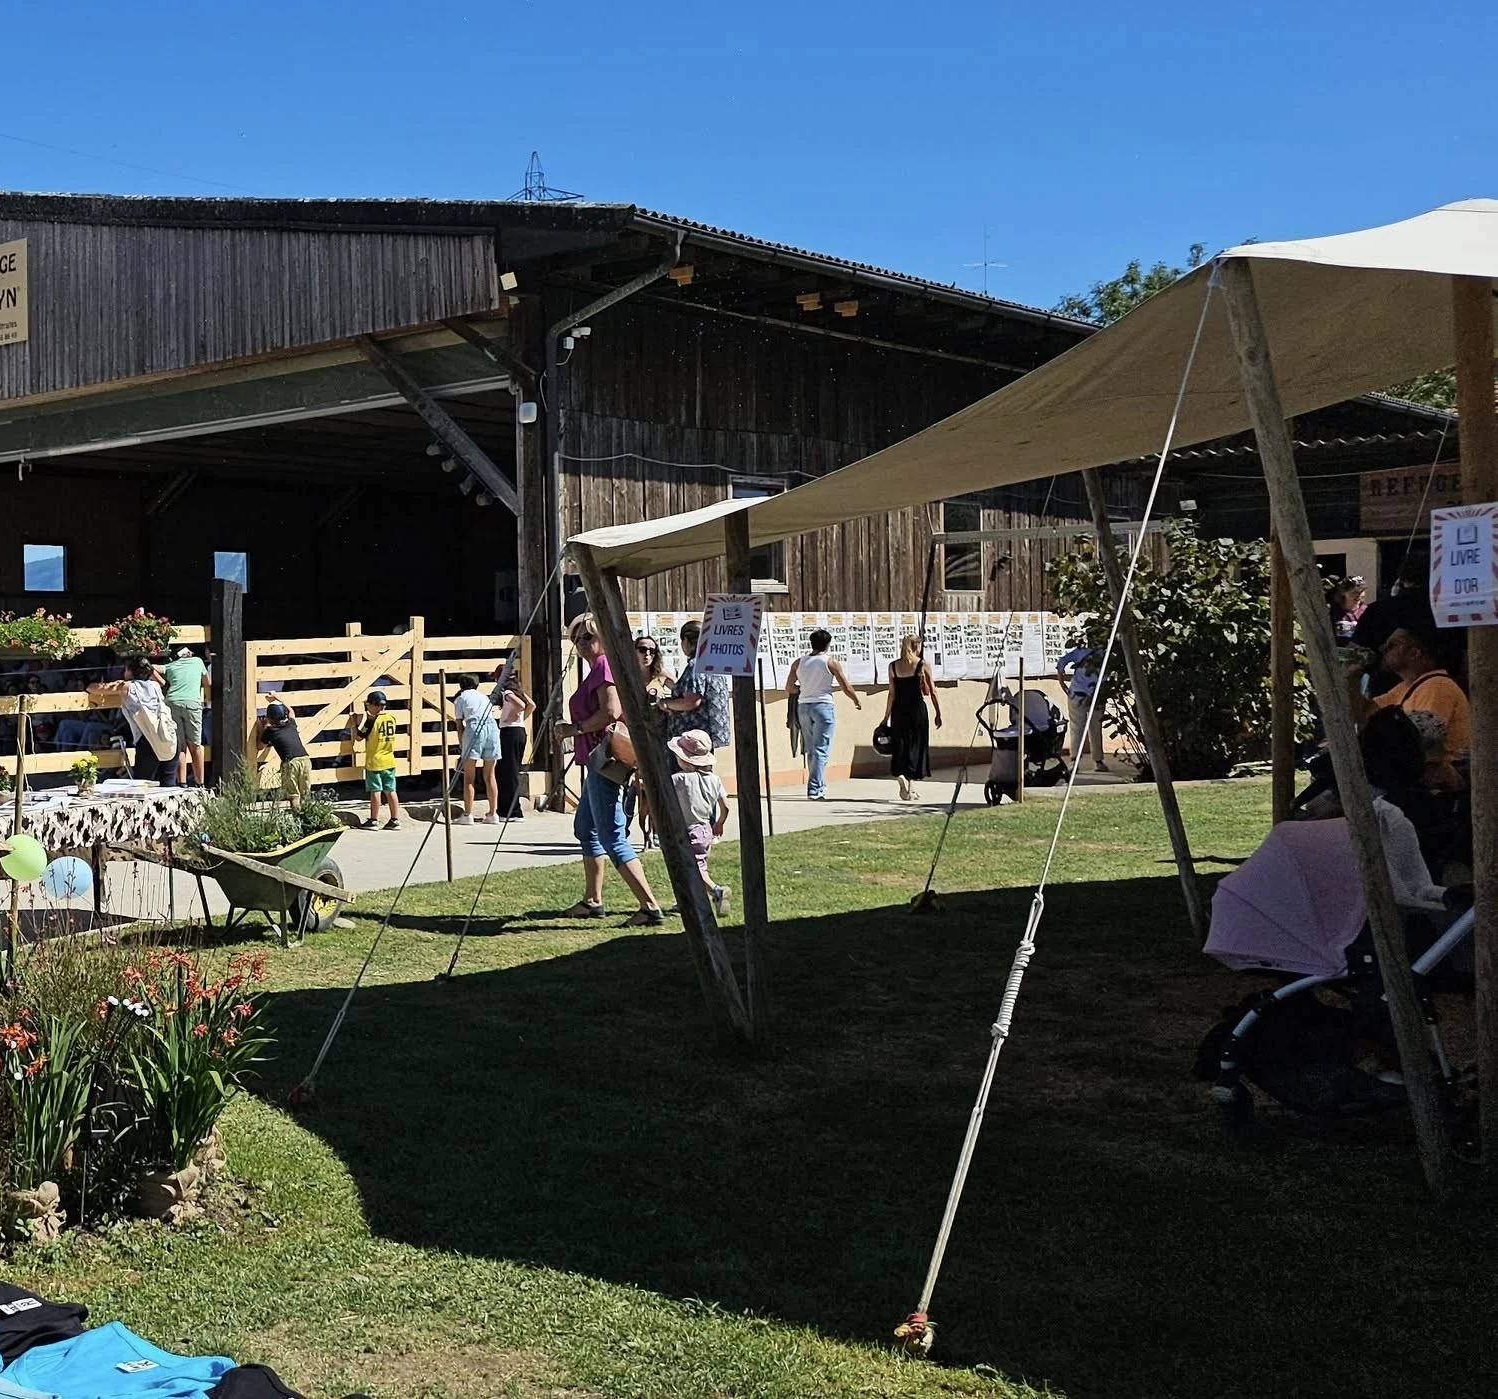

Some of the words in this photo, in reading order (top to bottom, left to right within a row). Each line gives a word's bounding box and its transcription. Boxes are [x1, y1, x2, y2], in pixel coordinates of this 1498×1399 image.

[1450, 548, 1481, 566] LIVRE
[1454, 577, 1479, 595] D'OR
[713, 623, 745, 636] LIVRES
[709, 642, 745, 656] PHOTOS
[378, 719, 394, 737] 46
